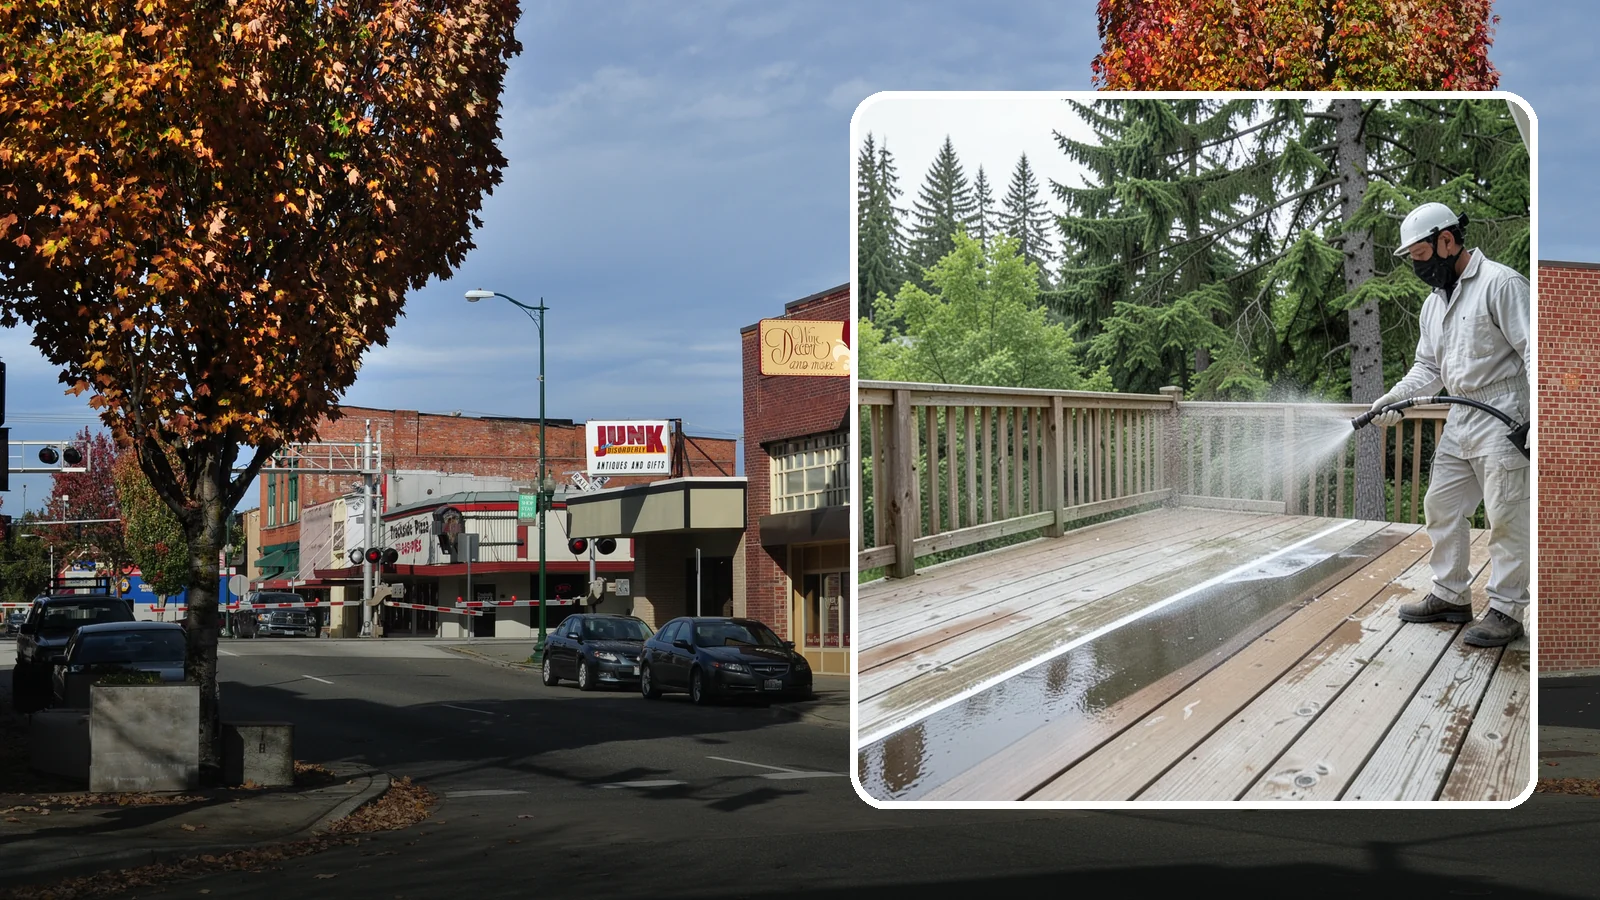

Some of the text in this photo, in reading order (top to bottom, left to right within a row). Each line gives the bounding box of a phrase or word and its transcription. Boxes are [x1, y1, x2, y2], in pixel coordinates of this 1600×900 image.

[595, 425, 666, 457] JUNK
[607, 446, 646, 454] DISORDERLY
[597, 460, 665, 470] ANTIQUES AND GIFTS
[573, 473, 589, 492] RAIL
[390, 519, 429, 540] Trackside Pizza
